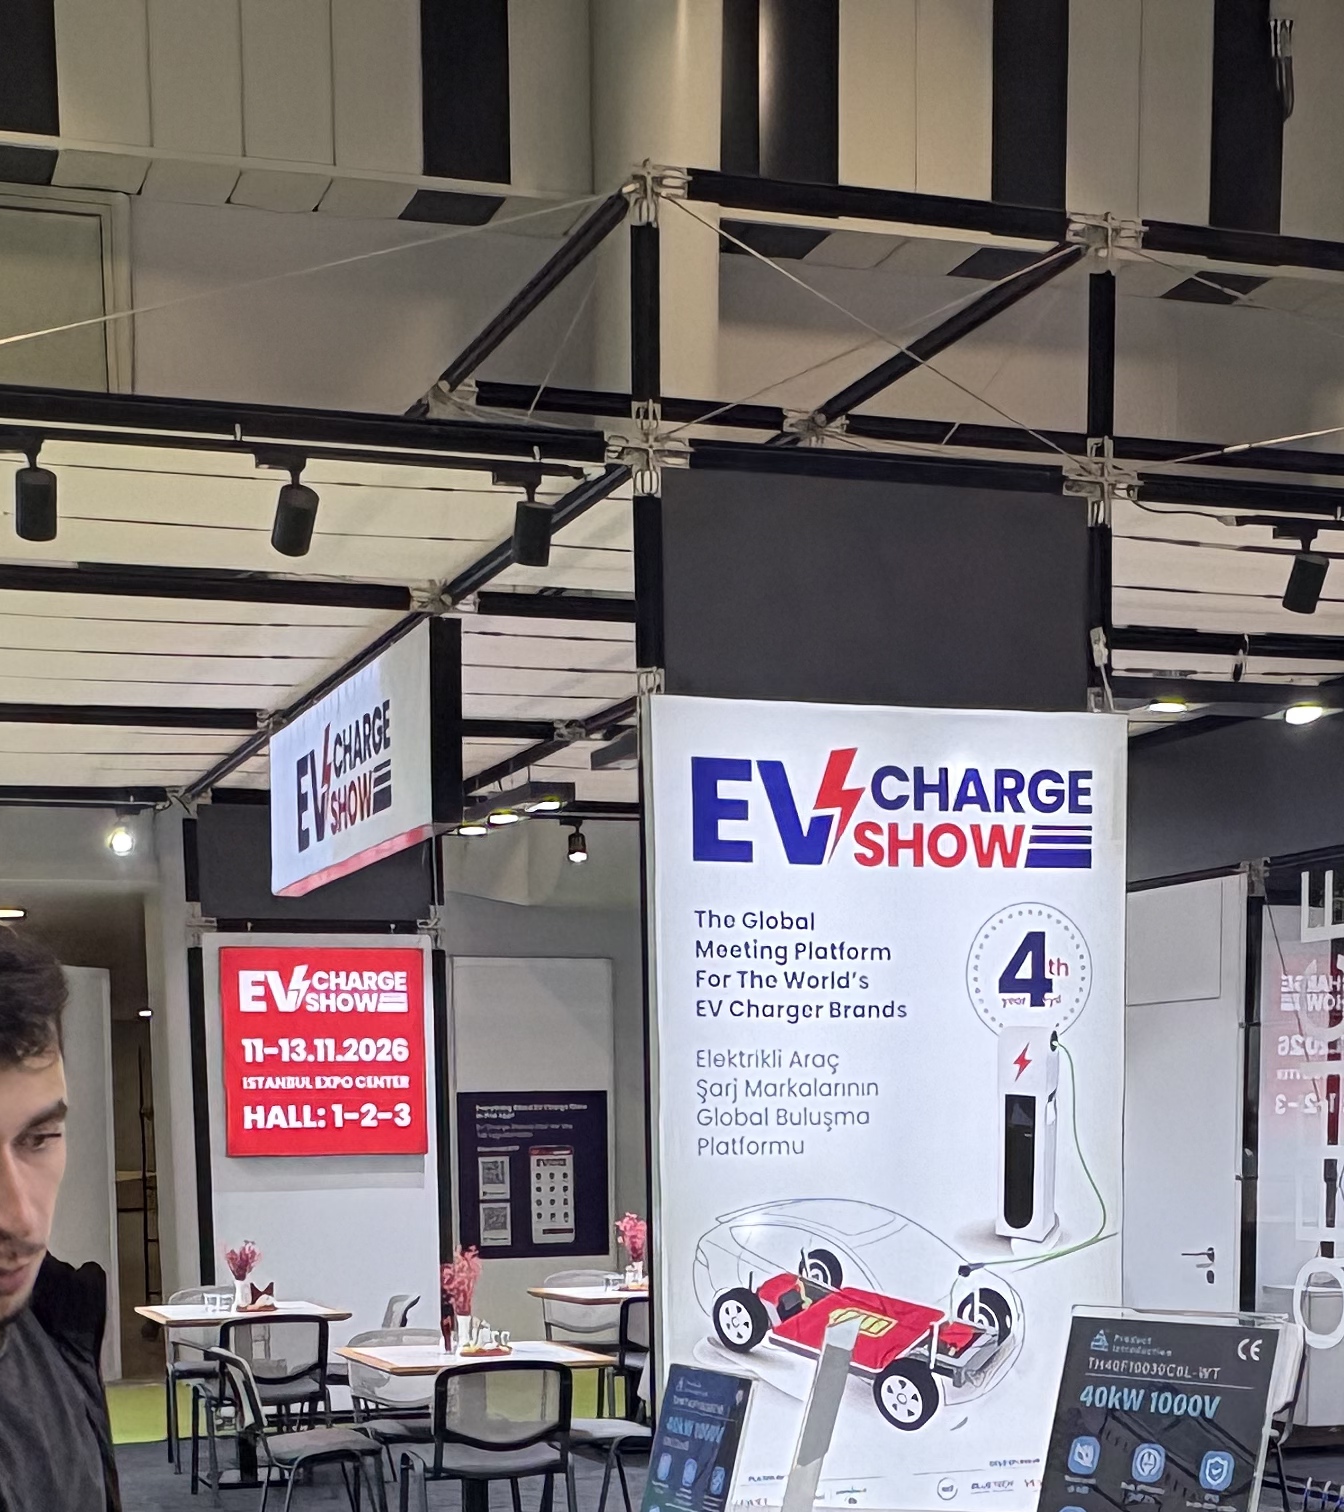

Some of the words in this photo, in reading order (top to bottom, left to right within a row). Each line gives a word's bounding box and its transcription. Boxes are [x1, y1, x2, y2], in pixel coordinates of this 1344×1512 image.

[296, 749, 329, 853] EV
[332, 699, 391, 779] CHARGE
[330, 769, 374, 836] SHOW
[691, 757, 835, 866] EV
[870, 765, 1093, 814] CHARGE
[854, 821, 1025, 868] SHOW
[694, 910, 735, 928] The
[742, 910, 815, 930] Global
[695, 939, 788, 965] Meeting
[795, 941, 891, 960] Platform
[238, 970, 301, 1013] EV
[311, 970, 407, 991] CHARGE
[696, 970, 731, 988] For
[736, 970, 778, 988] The
[783, 970, 869, 989] World's
[306, 992, 378, 1013] SHOW
[696, 1000, 723, 1017] EV
[729, 999, 824, 1024] Charger
[829, 1000, 907, 1019] Brands
[241, 1038, 409, 1063] 11-13.11.2026
[696, 1049, 782, 1068] Elektrikli
[789, 1050, 839, 1074] Araç
[242, 1076, 313, 1089] ISTANBUL
[315, 1076, 354, 1089] EXPO
[355, 1075, 410, 1089] CENTER
[696, 1078, 738, 1104] Şarj
[745, 1078, 879, 1098] Markalarının
[243, 1104, 327, 1129] HALL:
[331, 1103, 411, 1127] 1-2-3
[697, 1107, 769, 1126] Global
[776, 1107, 870, 1132] Buluşma
[697, 1136, 804, 1156] Platformu
[1079, 1384, 1145, 1412] 40kW
[1149, 1391, 1221, 1419] 1000V
